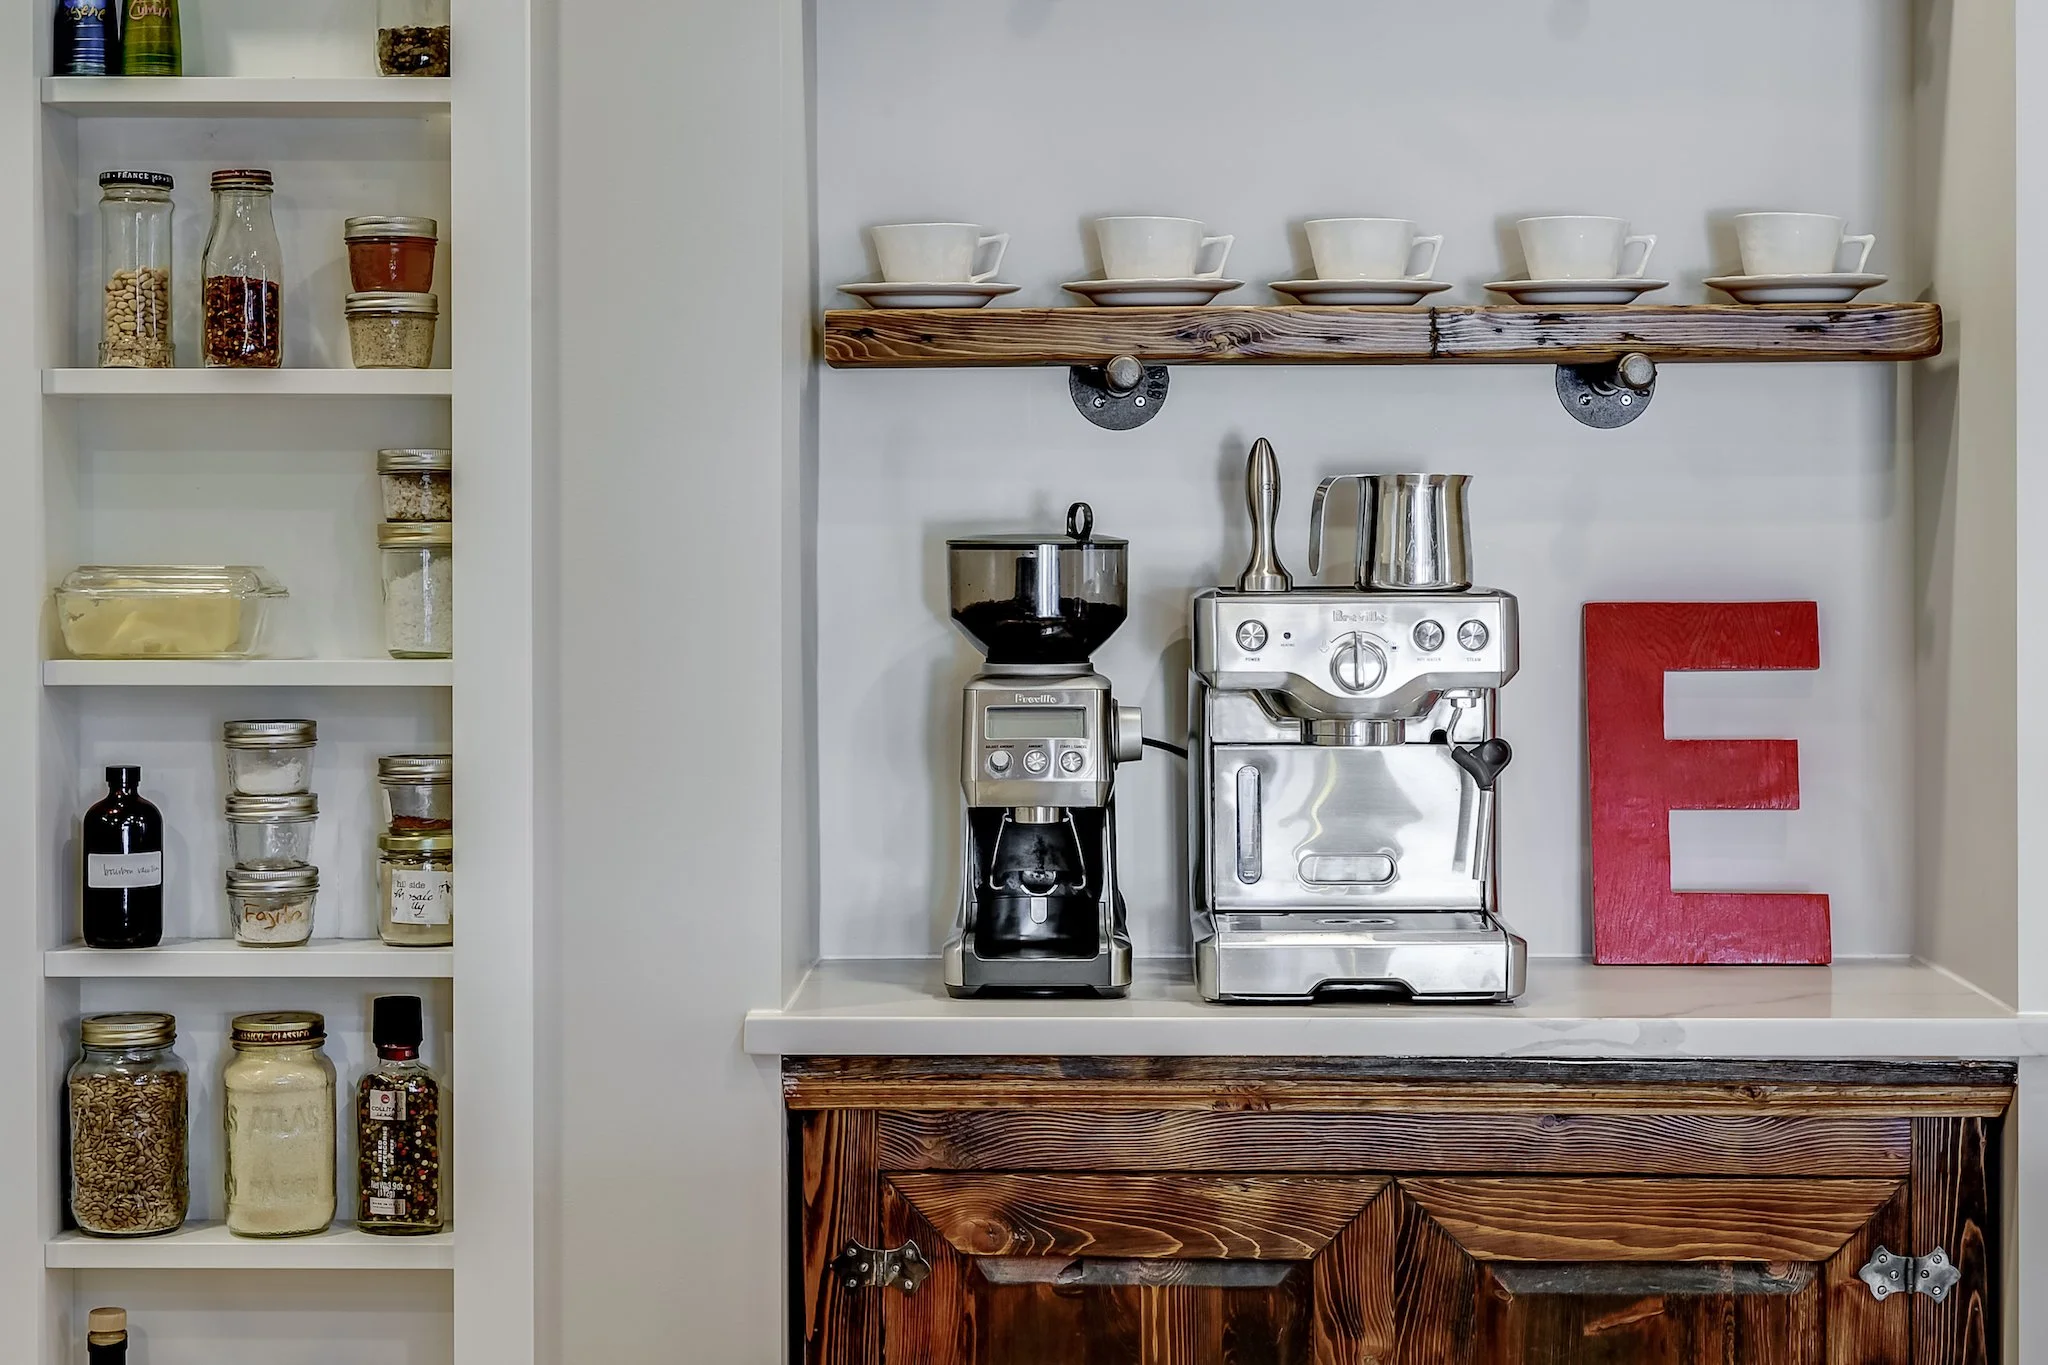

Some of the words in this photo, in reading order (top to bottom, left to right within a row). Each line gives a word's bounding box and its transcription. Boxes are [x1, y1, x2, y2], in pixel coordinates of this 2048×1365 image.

[117, 171, 149, 180] FRANCE
[1332, 610, 1388, 623] Breville
[1015, 693, 1057, 704] Breville
[1582, 600, 1831, 966] E
[103, 863, 134, 876] bourbon
[271, 1030, 310, 1042] CLASSICO
